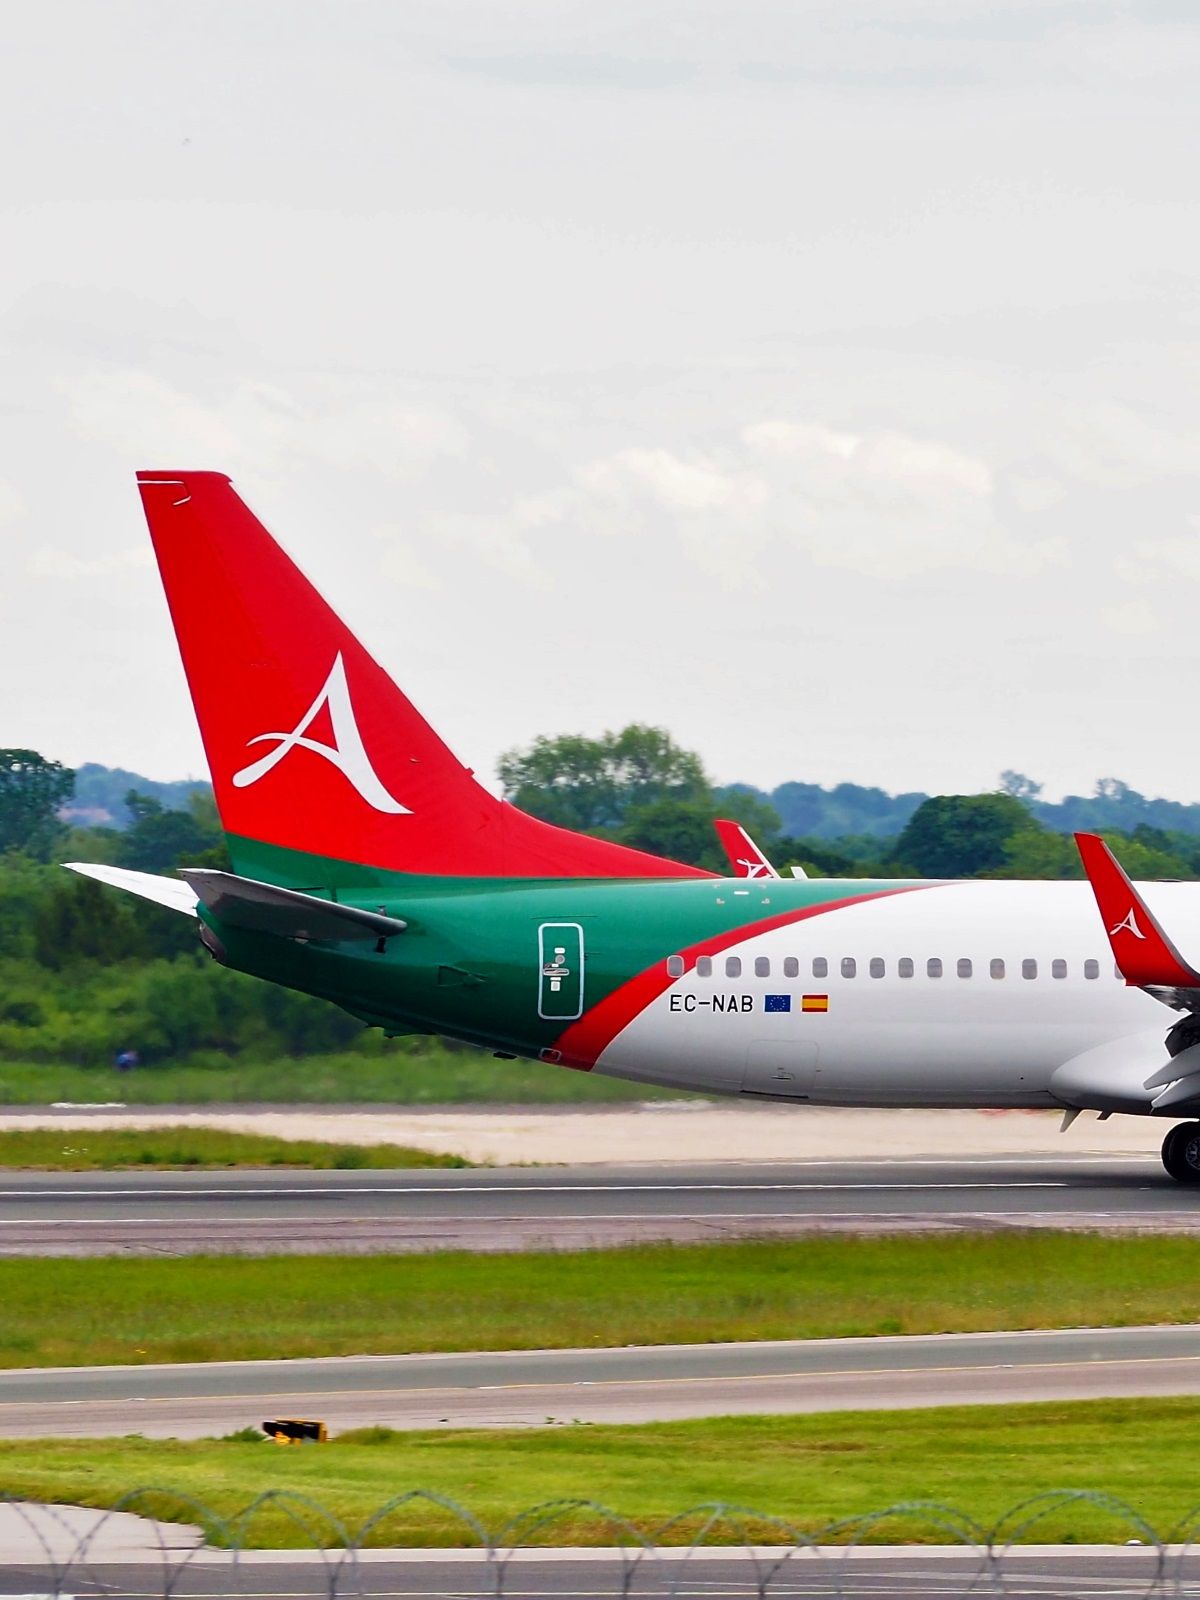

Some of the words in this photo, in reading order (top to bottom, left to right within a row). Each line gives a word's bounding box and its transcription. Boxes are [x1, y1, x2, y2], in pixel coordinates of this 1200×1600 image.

[232, 649, 415, 814] A
[1109, 907, 1147, 939] A
[669, 994, 754, 1013] EC-NAB
